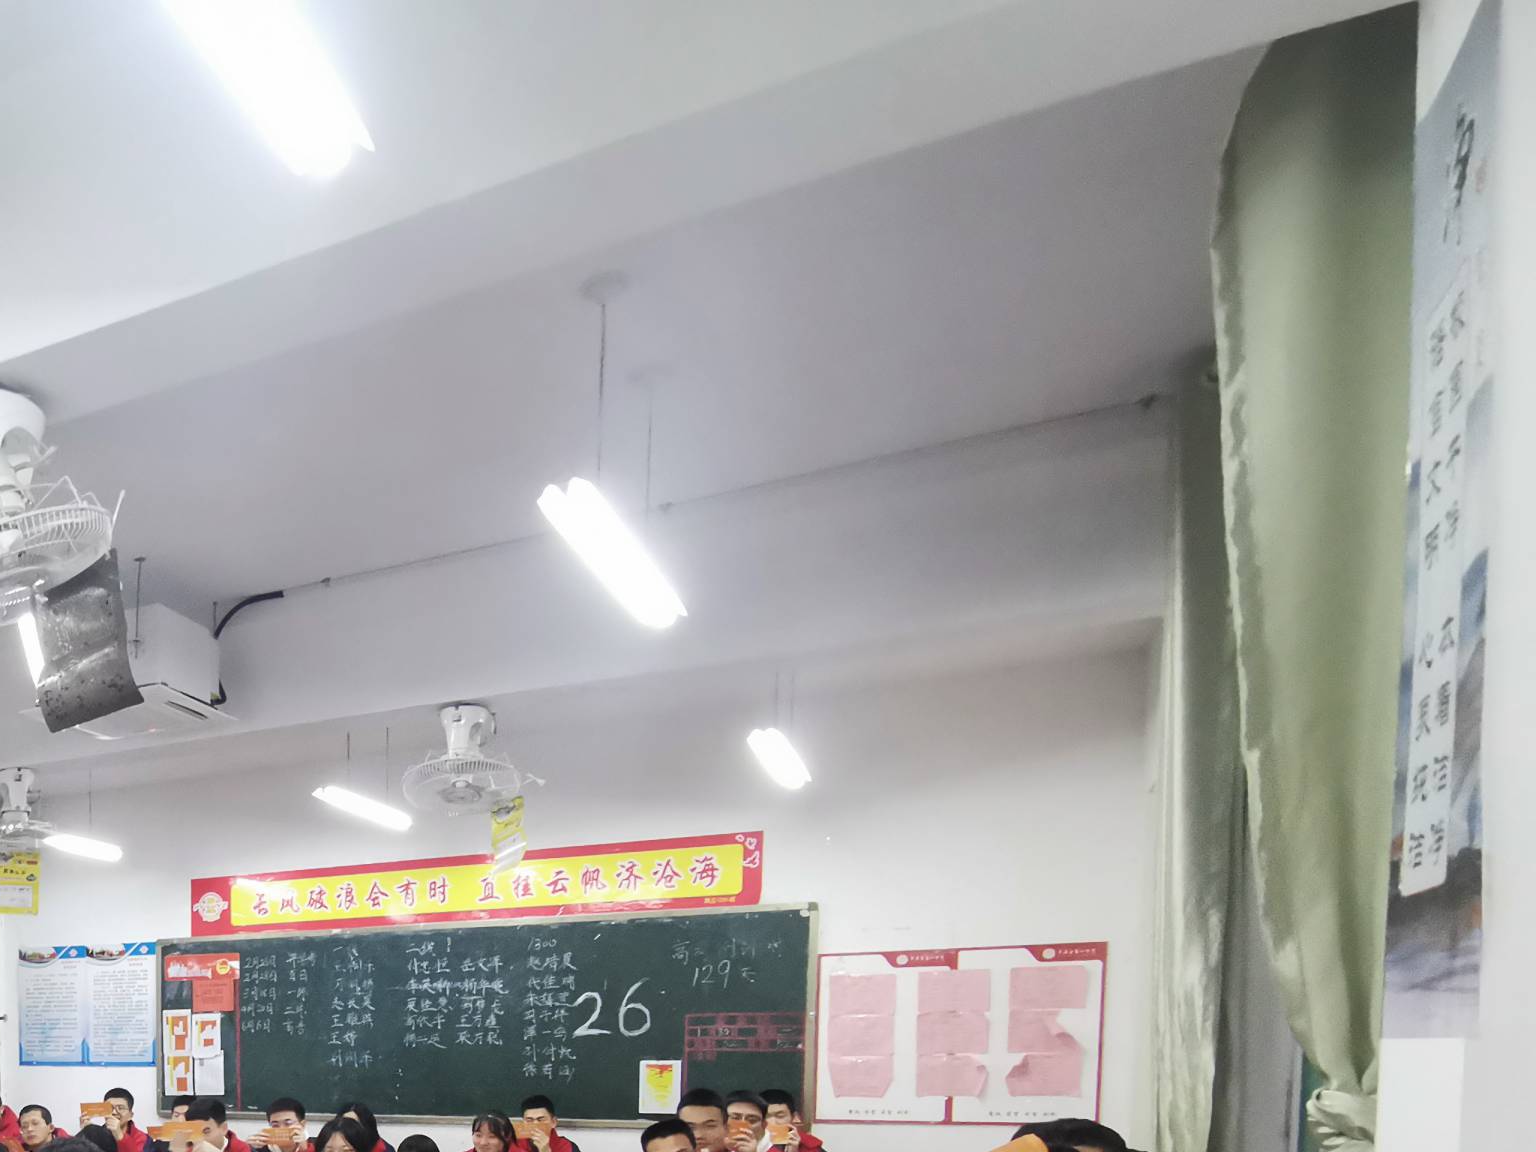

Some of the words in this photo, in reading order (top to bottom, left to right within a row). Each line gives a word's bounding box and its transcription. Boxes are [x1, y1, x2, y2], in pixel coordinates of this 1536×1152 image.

[477, 855, 721, 903] 直挂云帆济沧海
[572, 976, 651, 1038] 26
